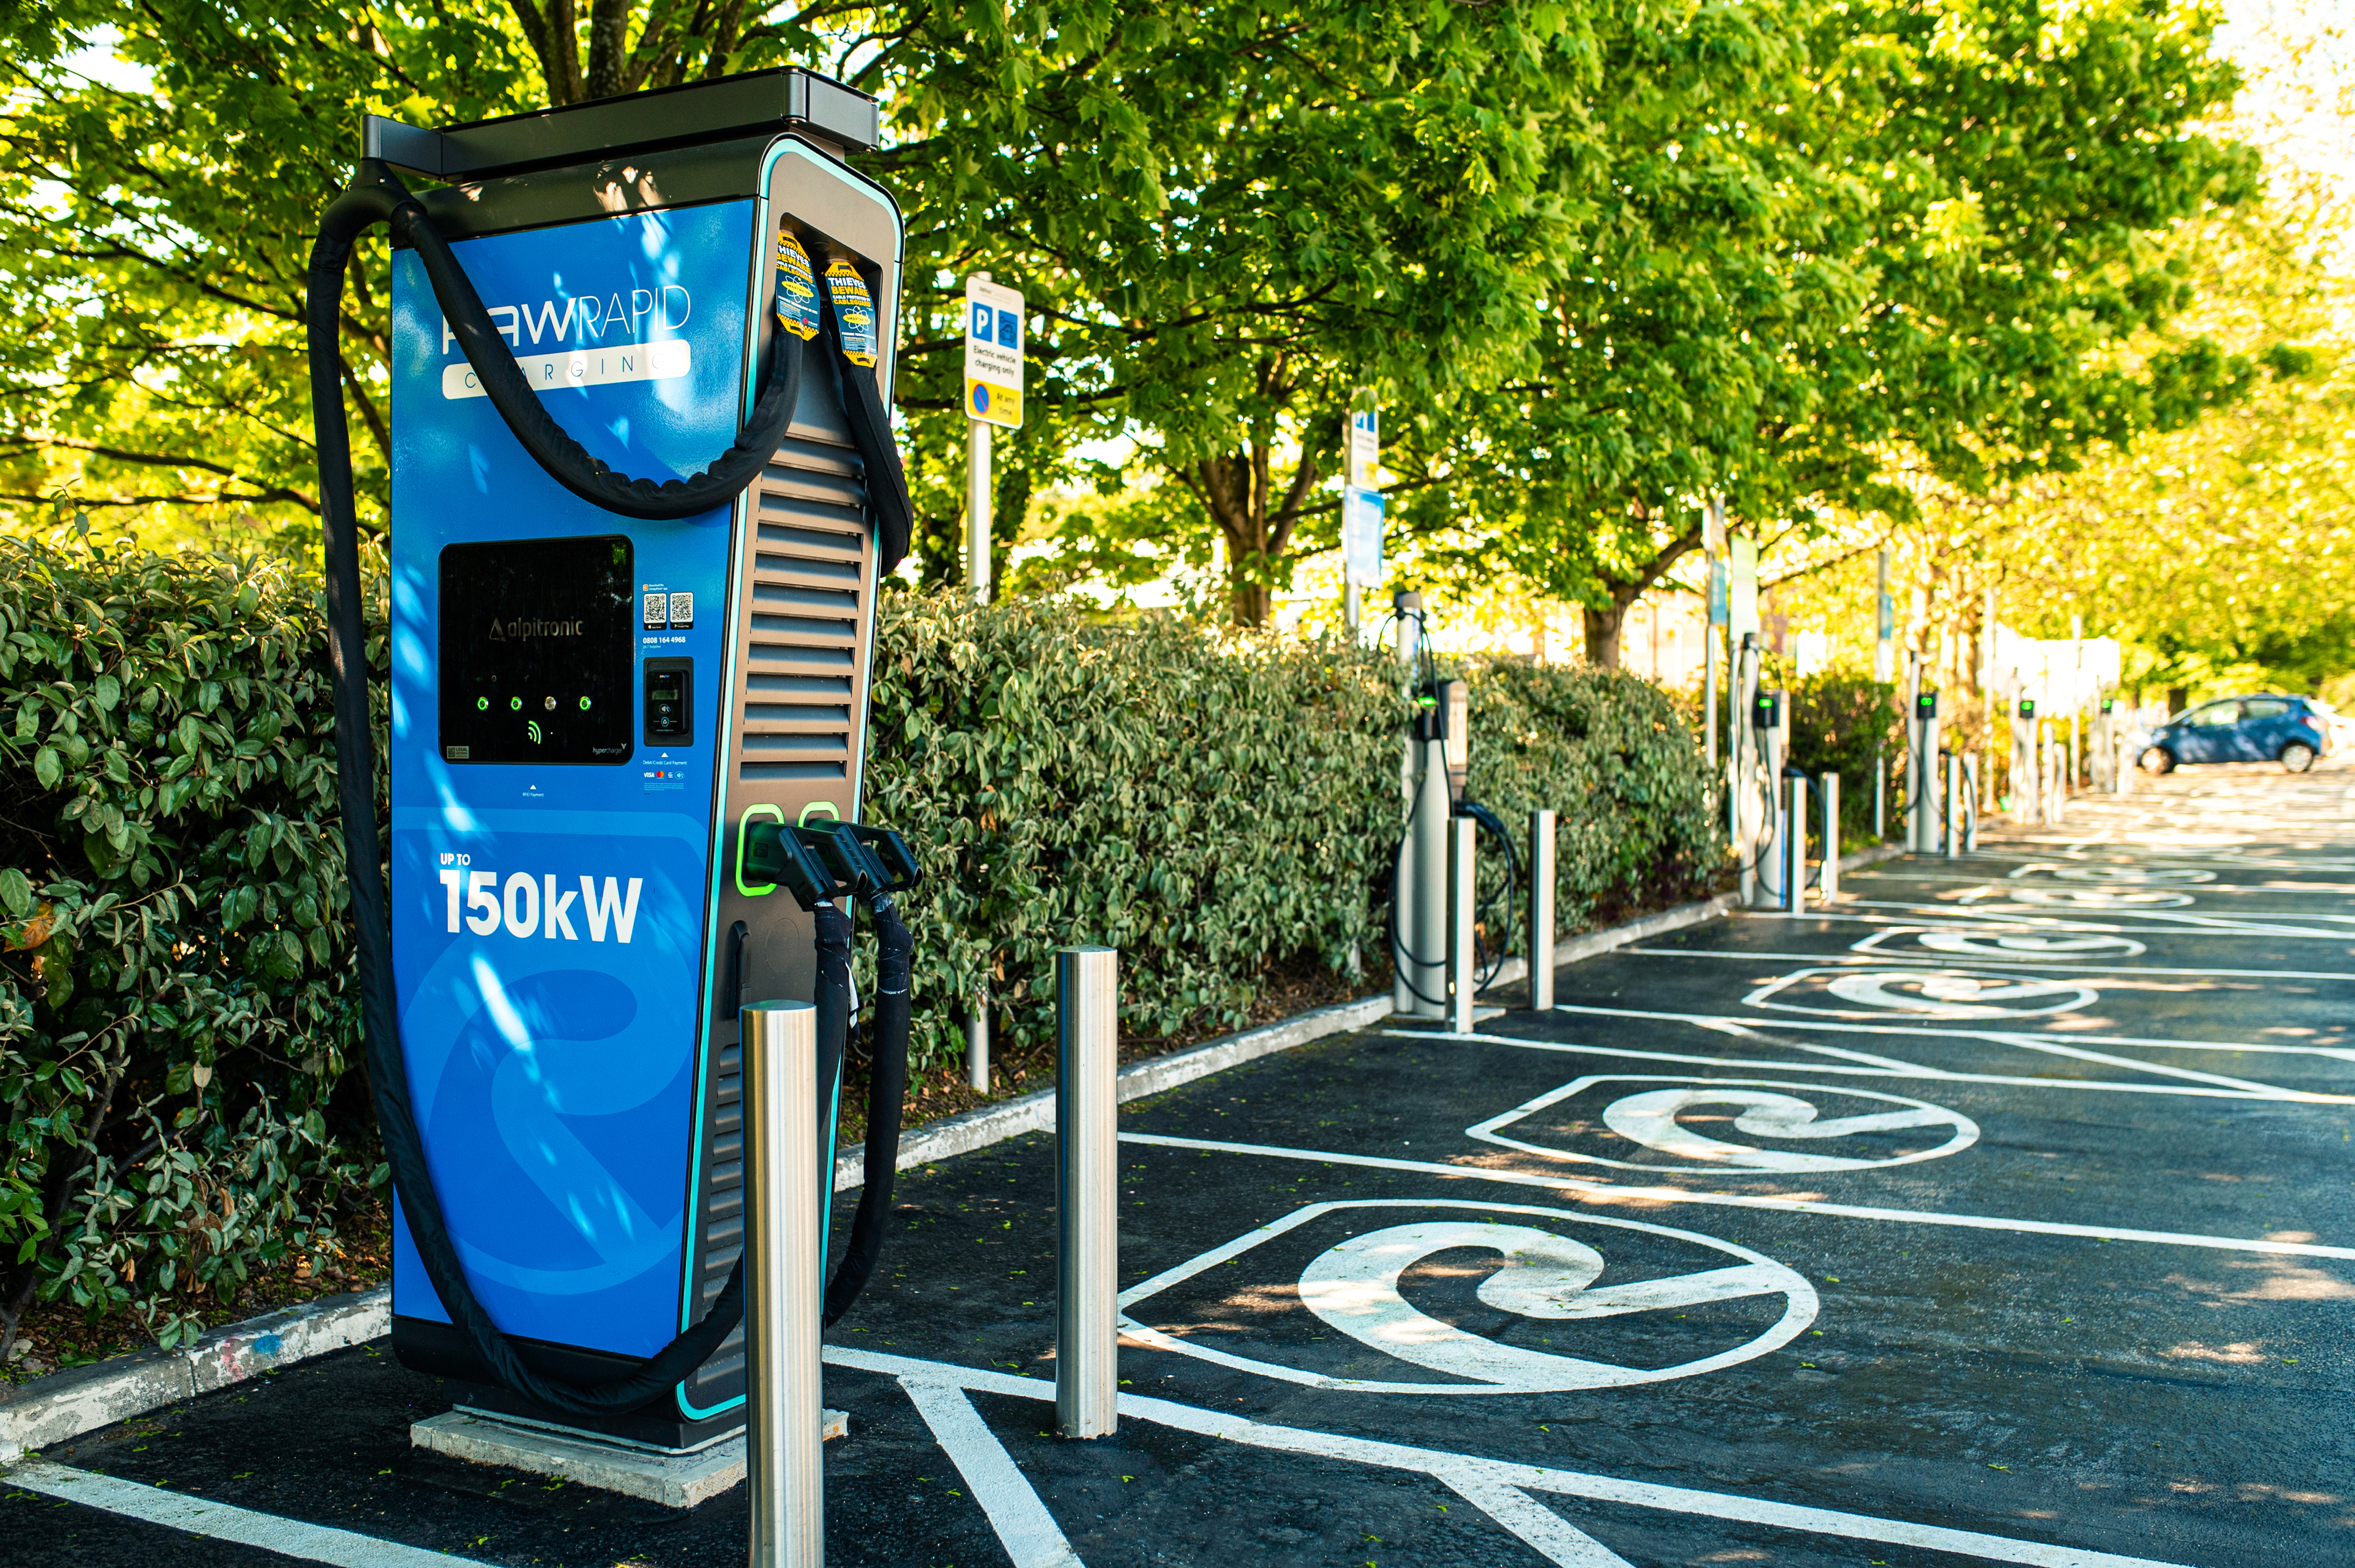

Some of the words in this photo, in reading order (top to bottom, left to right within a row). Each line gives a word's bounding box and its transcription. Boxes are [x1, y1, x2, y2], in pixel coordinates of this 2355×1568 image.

[778, 245, 810, 267] HIEVES
[828, 277, 866, 289] THIEVES
[831, 286, 869, 297] BEWARE
[834, 299, 871, 307] CABLEGUARD
[977, 308, 989, 335] P
[973, 345, 995, 358] Electric
[996, 353, 1016, 364] vehicle
[465, 353, 665, 388] CRGING
[974, 358, 1001, 375] charging
[1002, 367, 1014, 378] only
[508, 615, 584, 641] alpitronic
[592, 747, 622, 755] hypercharger
[440, 853, 454, 865] UP
[456, 853, 470, 866] TO
[440, 869, 643, 943] 150kW
